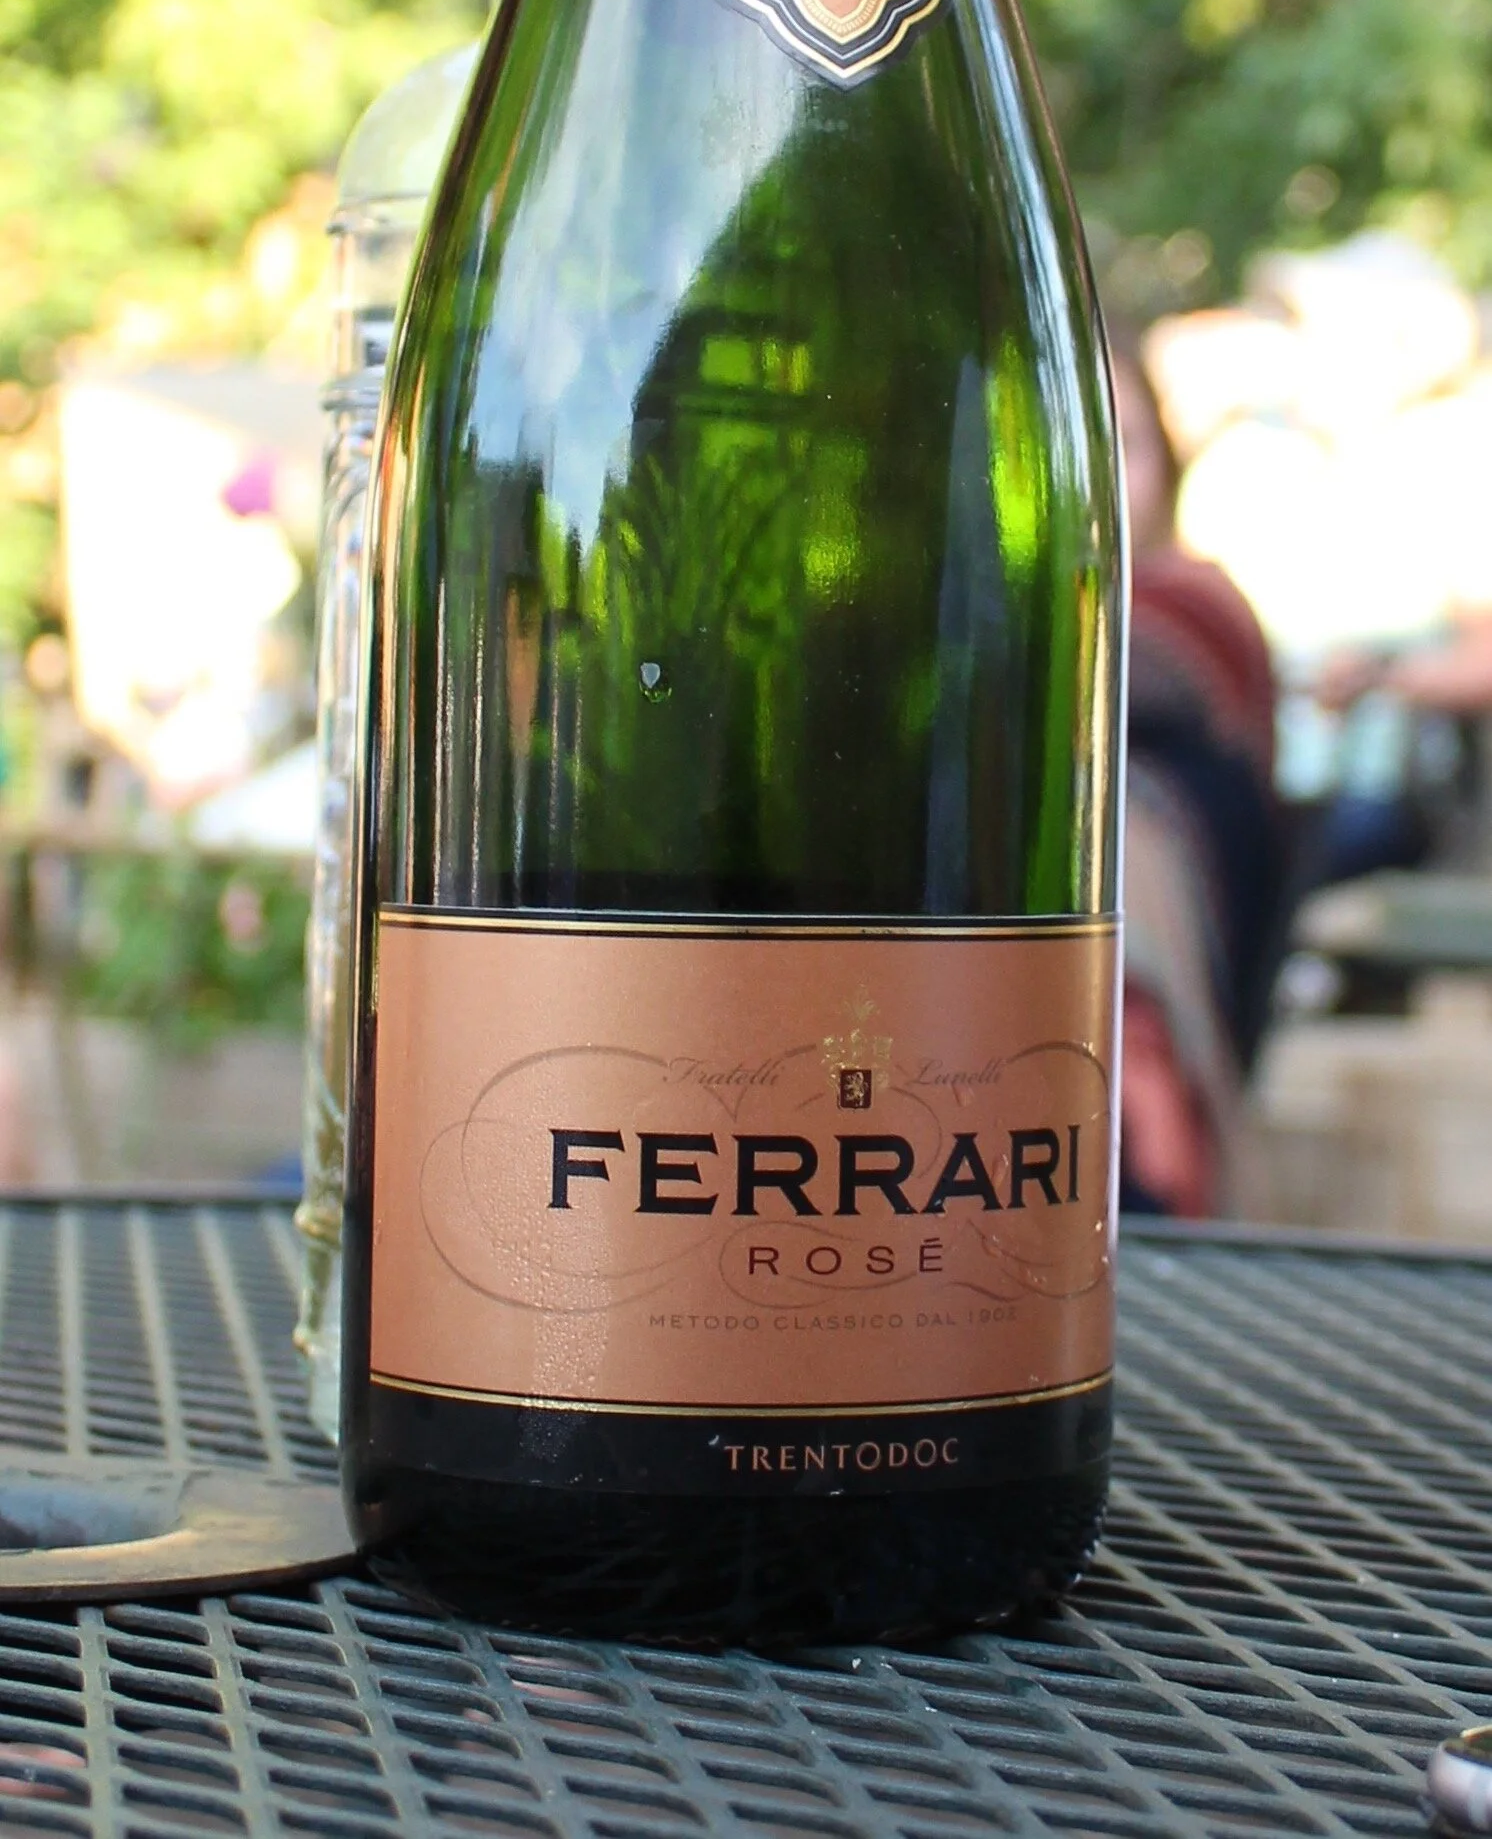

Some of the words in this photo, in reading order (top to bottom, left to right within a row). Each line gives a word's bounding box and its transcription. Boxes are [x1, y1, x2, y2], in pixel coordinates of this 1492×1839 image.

[547, 1124, 1081, 1217] FERRARI
[747, 1237, 944, 1276] ROSÉ
[650, 1314, 761, 1331] METODO
[774, 1314, 904, 1331] CLASSICO
[916, 1312, 957, 1328] DAL
[723, 1438, 959, 1471] TRENTODOC
